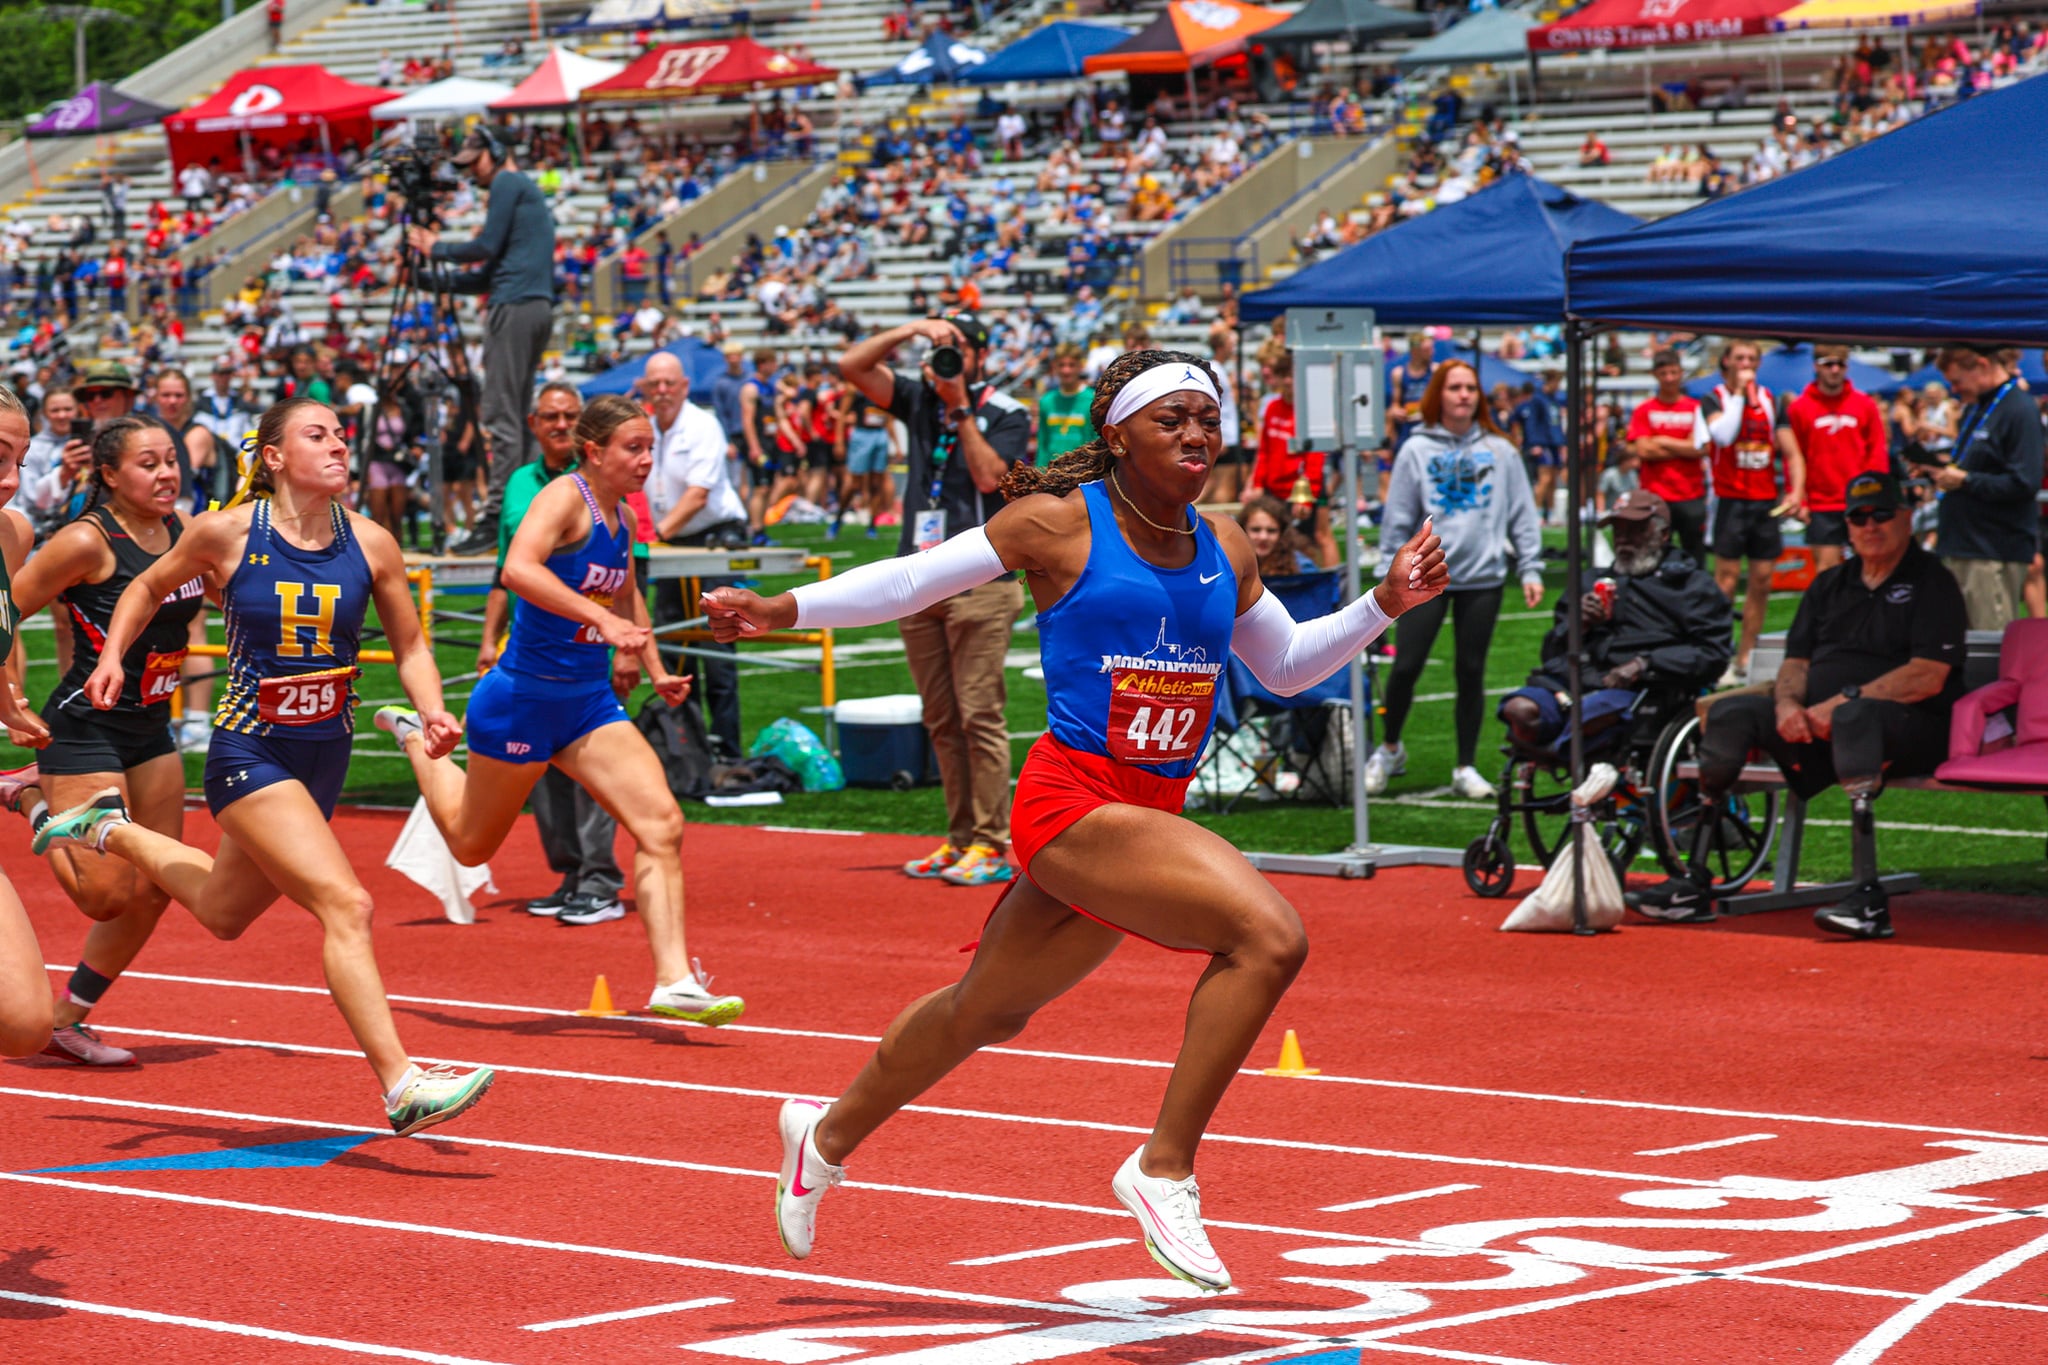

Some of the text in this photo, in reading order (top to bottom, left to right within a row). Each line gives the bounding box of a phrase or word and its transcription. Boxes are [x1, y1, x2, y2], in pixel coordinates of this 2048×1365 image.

[275, 581, 342, 657] H
[276, 682, 337, 716] 259
[505, 741, 531, 755] WP
[1127, 706, 1197, 751] 442
